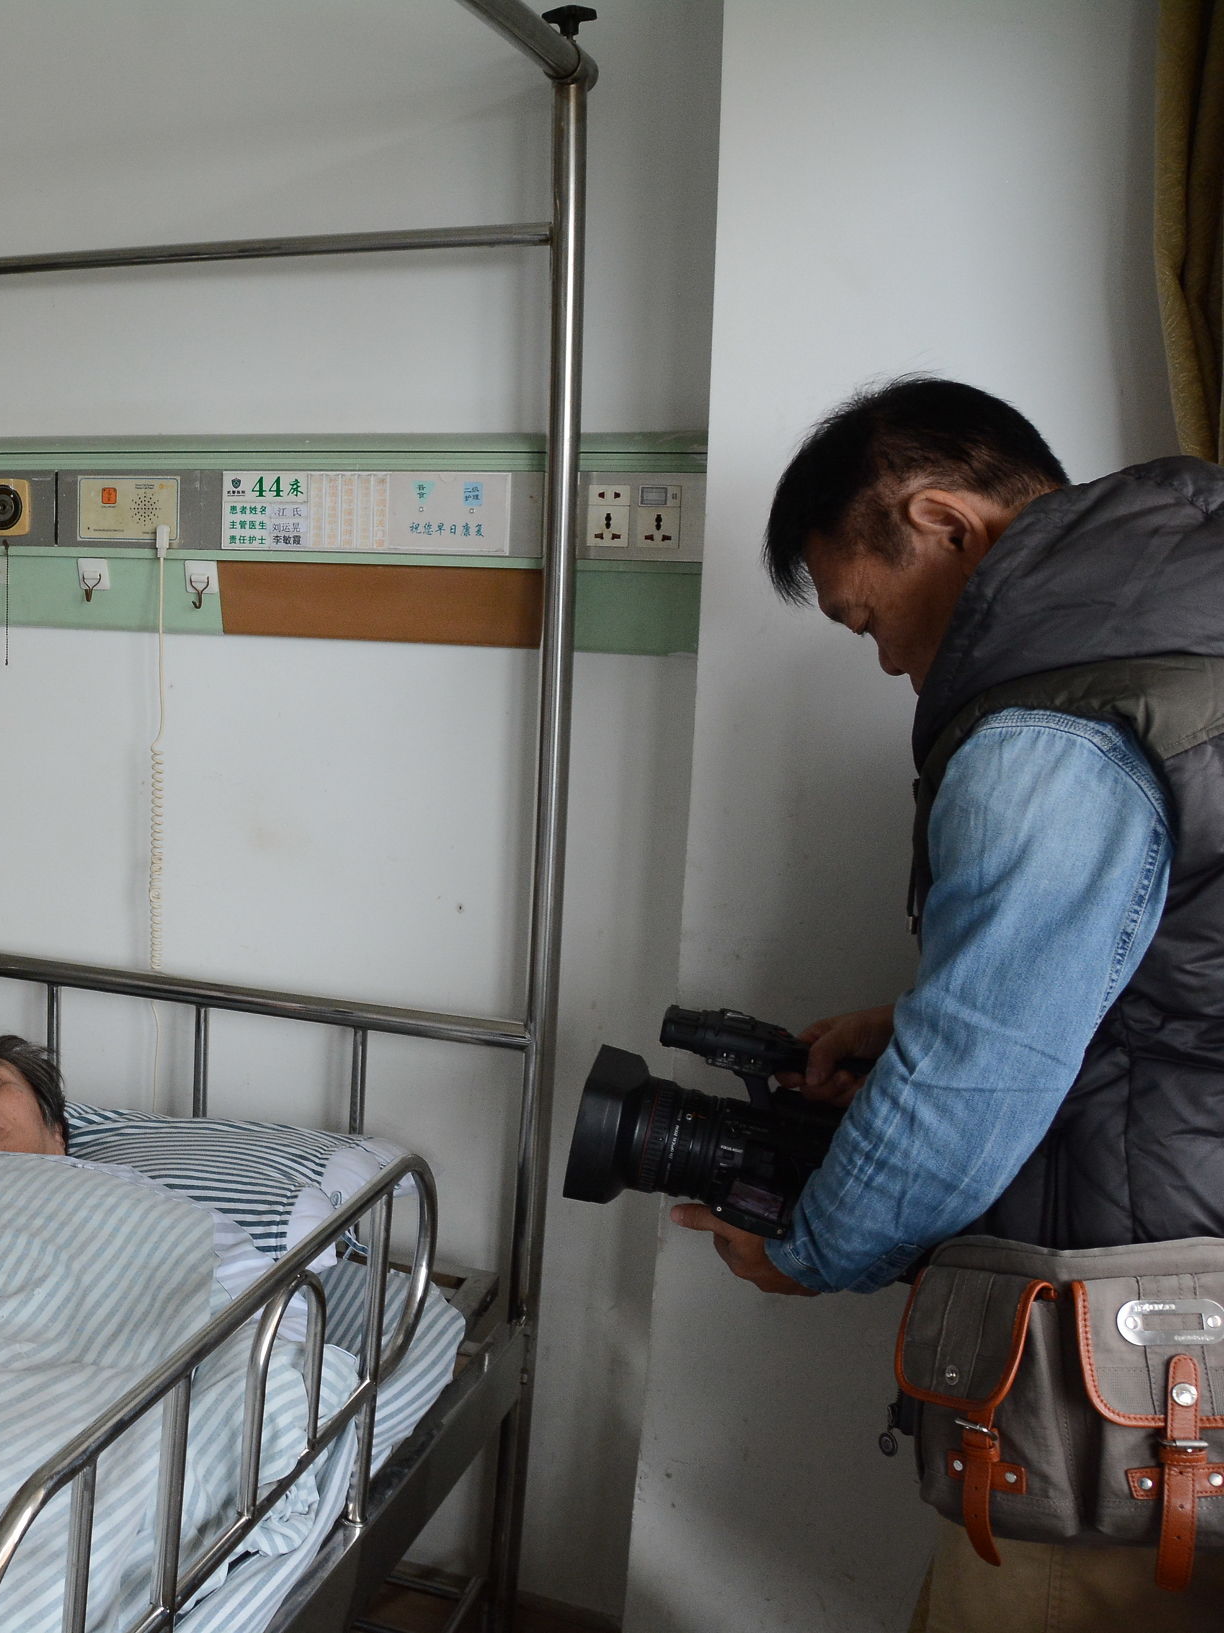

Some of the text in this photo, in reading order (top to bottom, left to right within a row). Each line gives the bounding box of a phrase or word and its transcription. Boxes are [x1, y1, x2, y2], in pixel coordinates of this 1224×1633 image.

[229, 505, 267, 515] 患者姓名
[229, 520, 267, 530] 主管医生
[409, 521, 484, 538] 祝您早日康复
[229, 535, 302, 545] 责任护士 李敏霞
